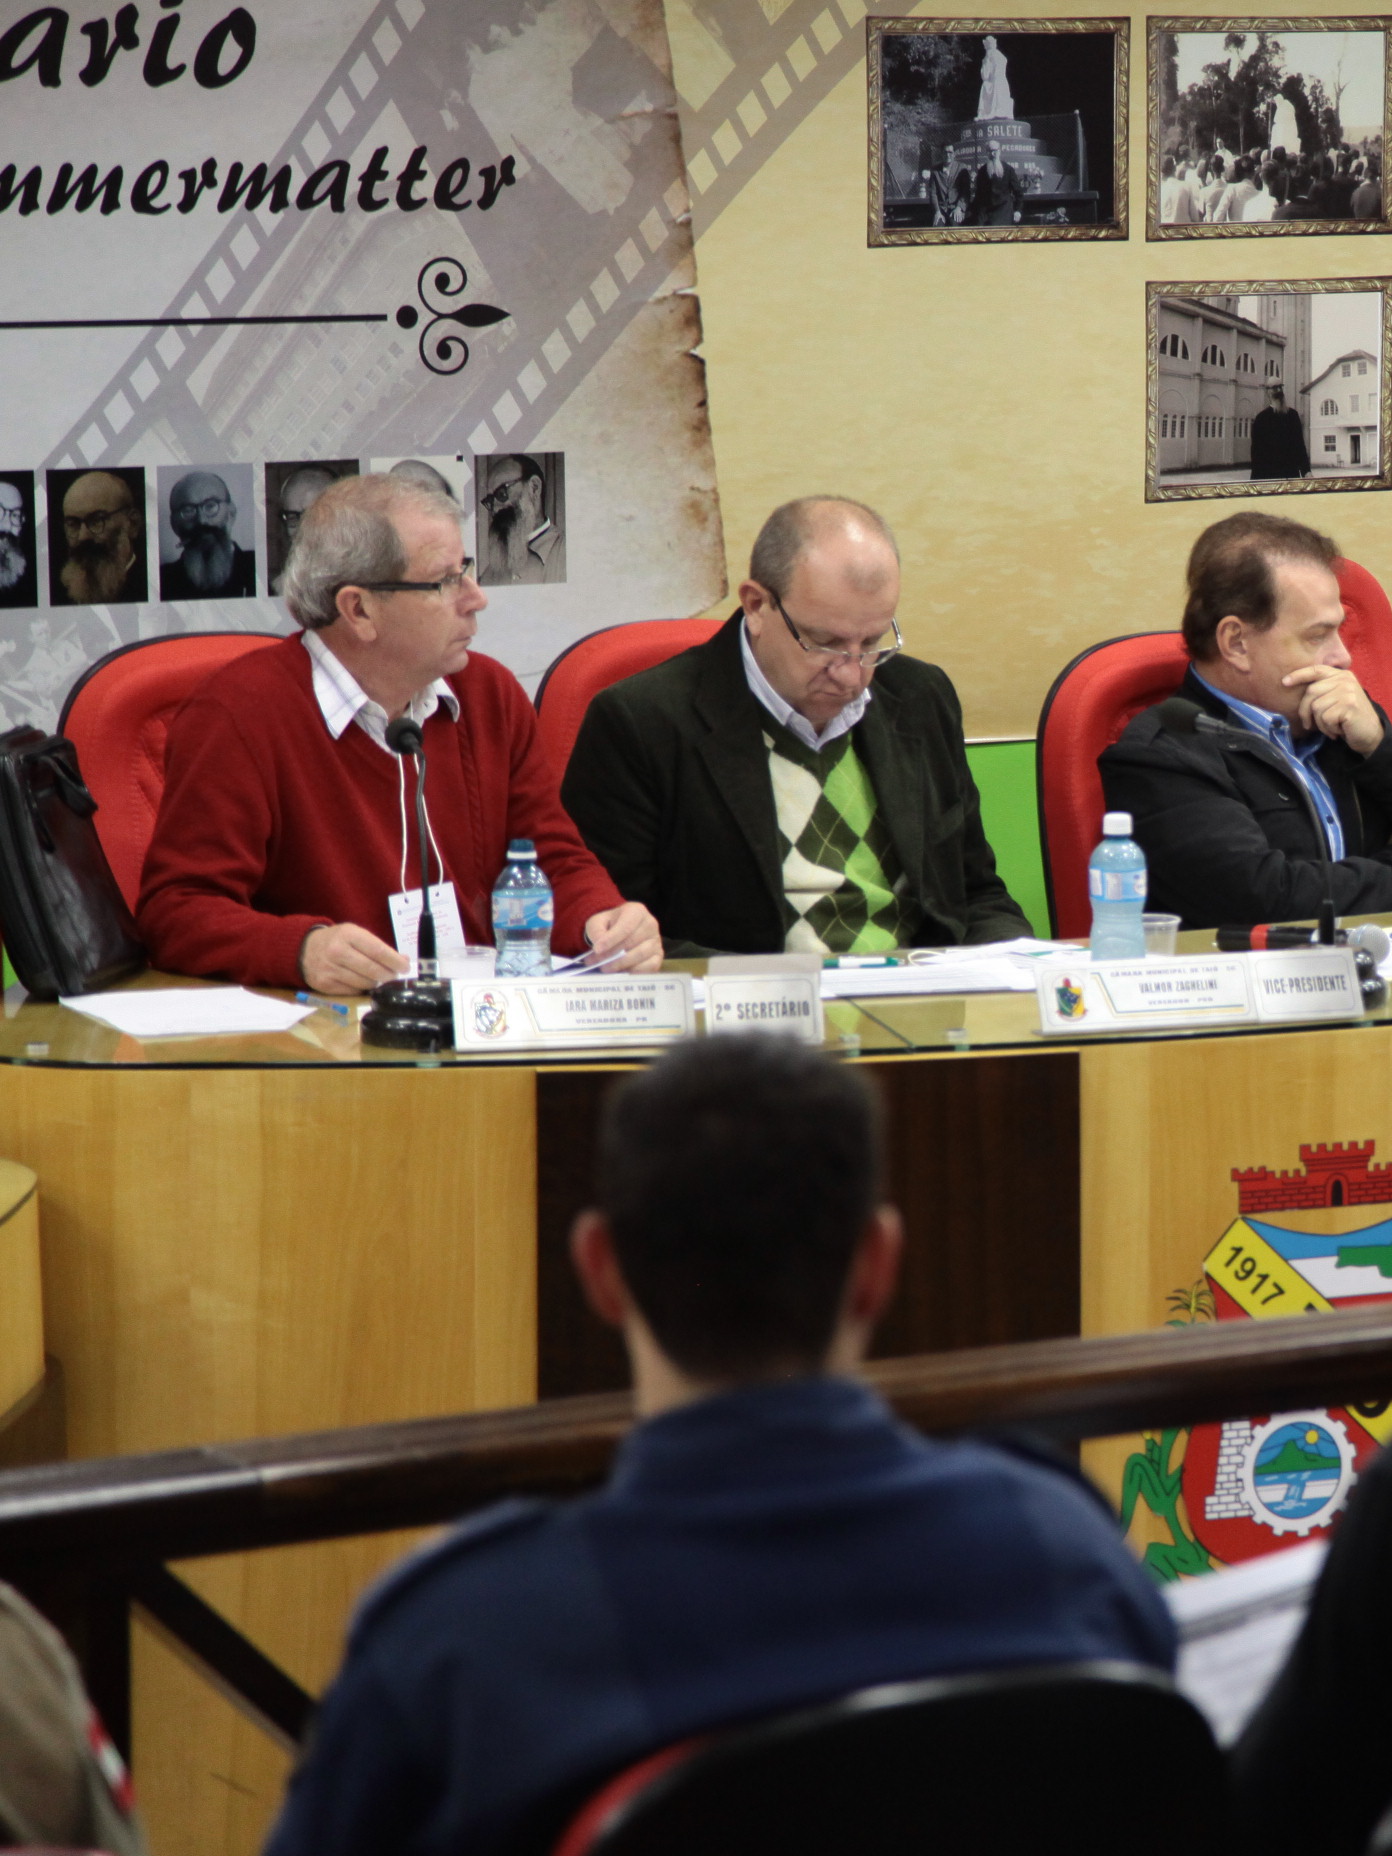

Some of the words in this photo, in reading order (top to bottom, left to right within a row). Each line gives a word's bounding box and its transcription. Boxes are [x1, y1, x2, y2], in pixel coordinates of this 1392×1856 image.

[1263, 974, 1347, 996] VICE-PRESIDENTE
[737, 996, 810, 1020] SECRETÁRIO
[1224, 1245, 1286, 1306] 1917
